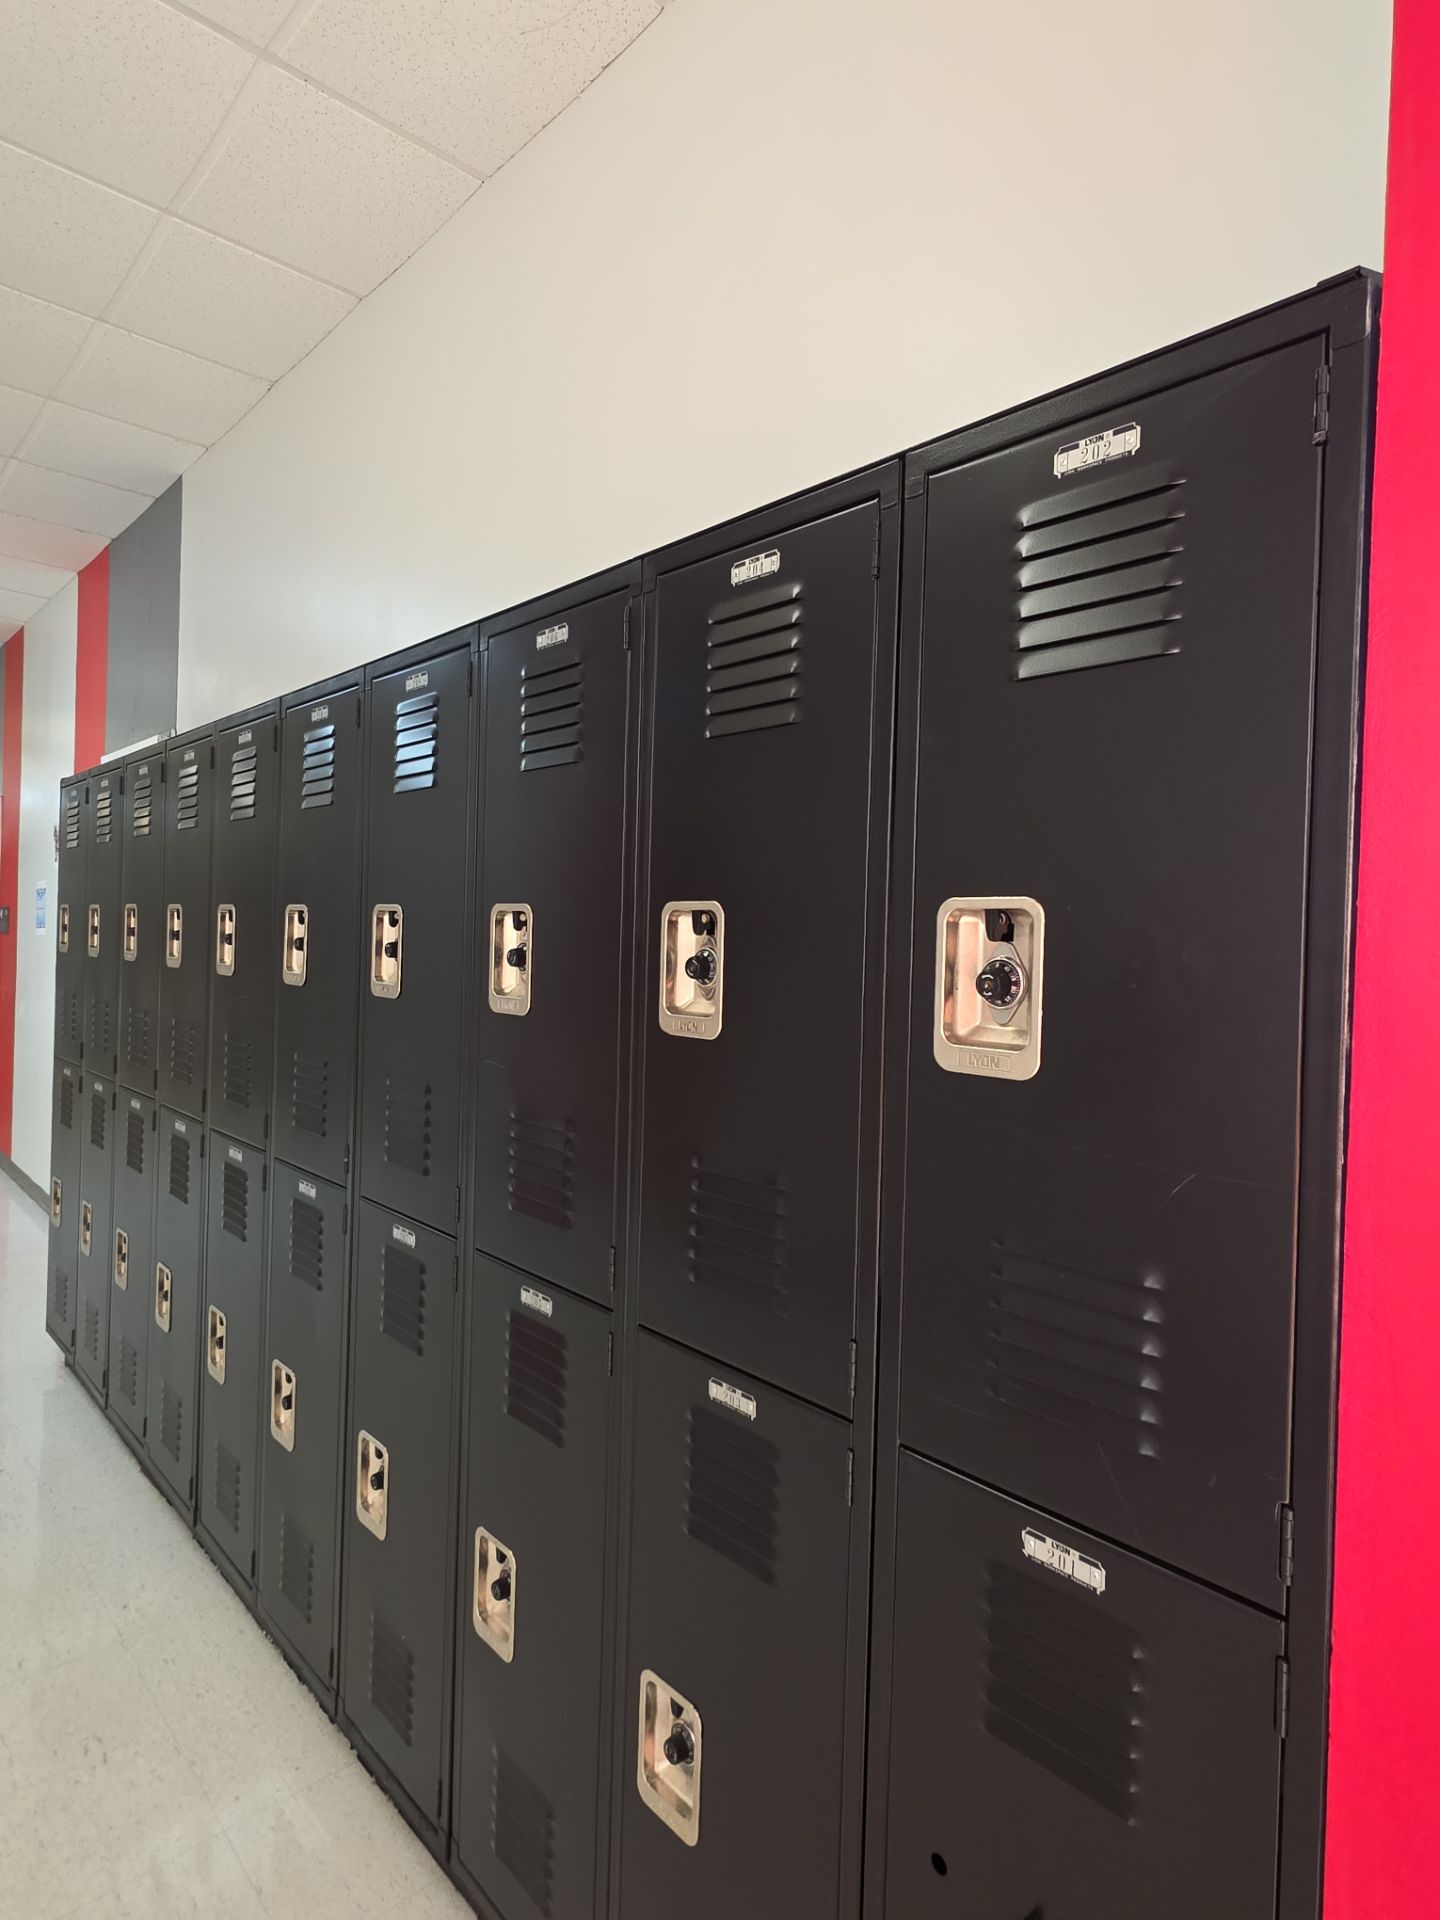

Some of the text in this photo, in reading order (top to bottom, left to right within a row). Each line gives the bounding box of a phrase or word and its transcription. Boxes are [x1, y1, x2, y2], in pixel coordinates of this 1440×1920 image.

[1084, 434, 1104, 447] LYON
[1081, 441, 1111, 464] 202
[746, 561, 764, 578] 204
[967, 1054, 999, 1070] LYON
[1051, 1541, 1071, 1556] LYON
[1047, 1548, 1075, 1577] 201
